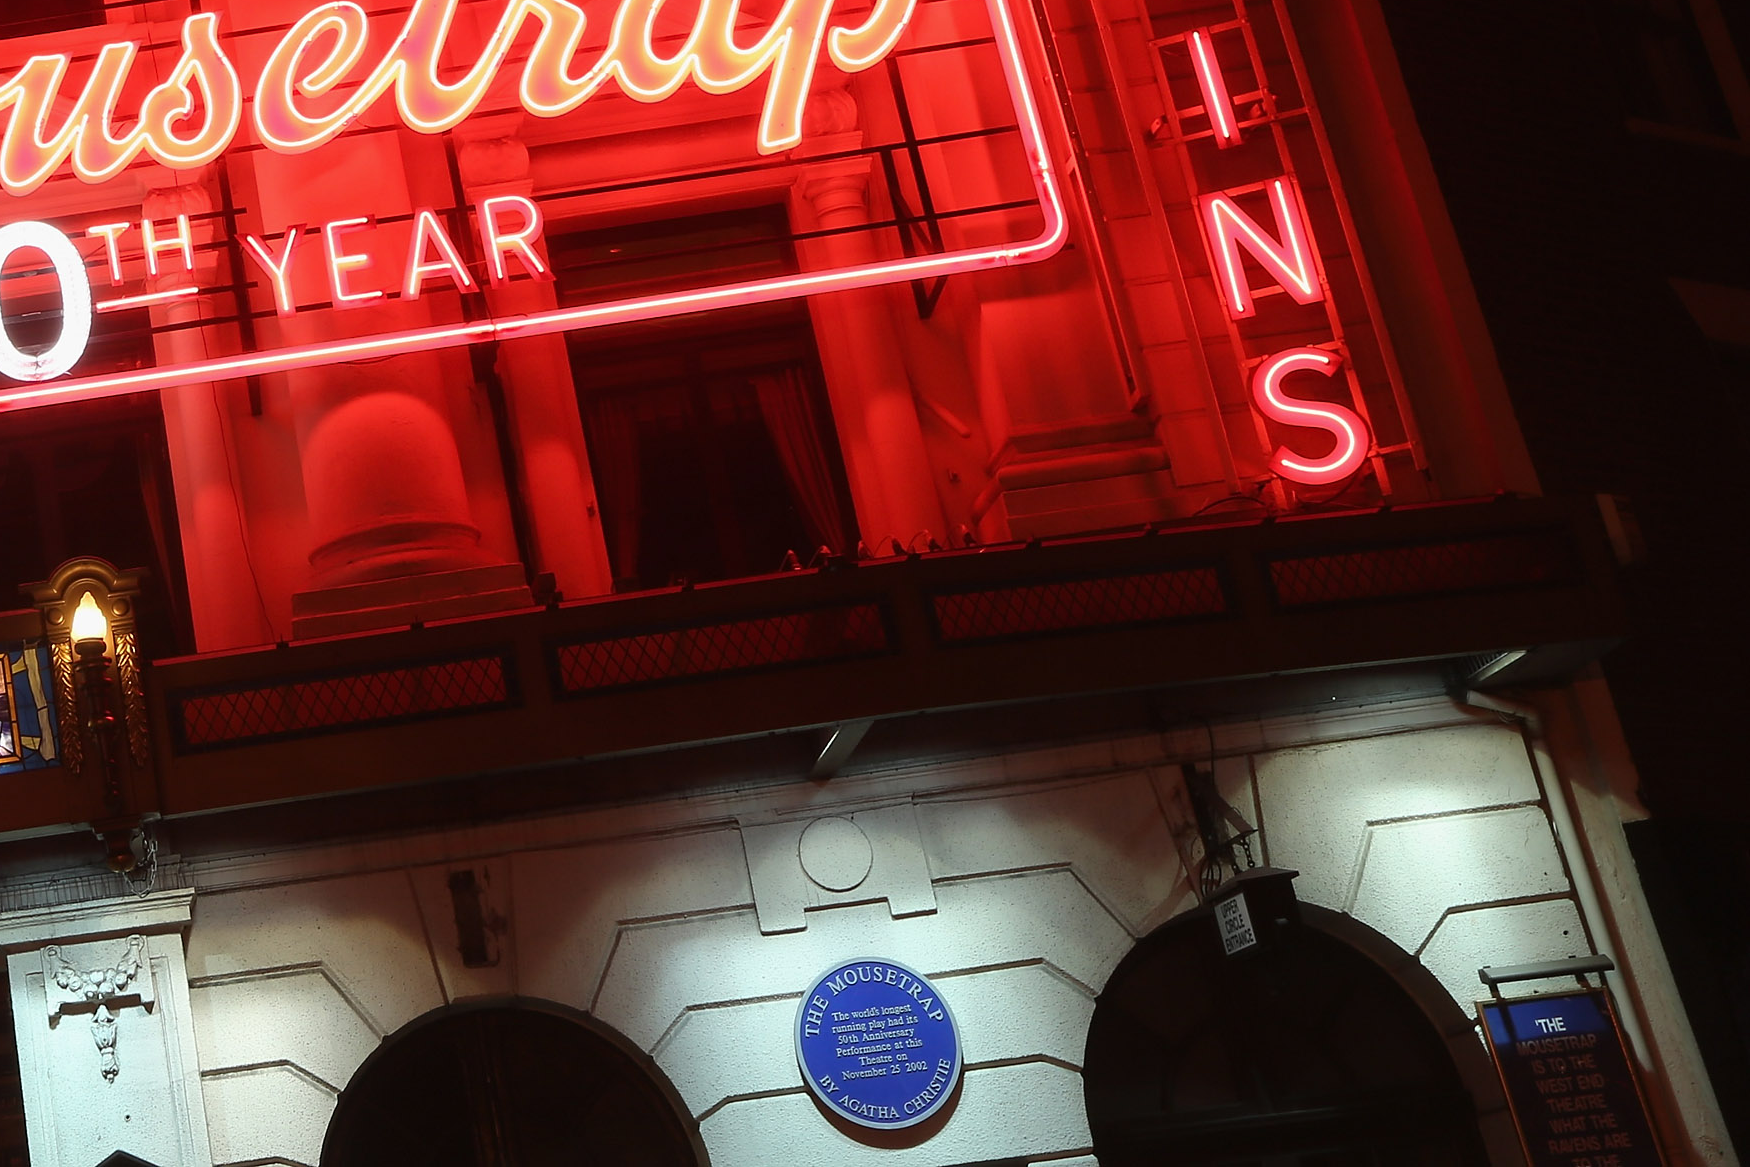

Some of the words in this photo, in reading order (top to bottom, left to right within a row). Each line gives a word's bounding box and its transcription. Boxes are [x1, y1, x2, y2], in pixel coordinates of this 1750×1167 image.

[237, 194, 557, 317] YEAR
[1220, 899, 1239, 919] UPPER
[1225, 914, 1245, 934] CIRCLE
[1225, 928, 1253, 952] ENTRANCE
[805, 994, 830, 1038] THE
[826, 966, 944, 1023] MOUSETRAP
[831, 1012, 850, 1021] The
[851, 1007, 880, 1018] world's
[881, 1004, 911, 1015] longest
[832, 1022, 866, 1033] running
[869, 1020, 885, 1031] play
[887, 1016, 904, 1026] had
[906, 1015, 919, 1024] its
[1535, 1016, 1567, 1034] 'THE
[838, 1034, 859, 1045] 50th
[862, 1028, 914, 1042] Anniversary
[1516, 1033, 1597, 1055] MOUSETRAP
[836, 1043, 892, 1057] Performance
[894, 1041, 903, 1049] at
[905, 1038, 923, 1048] this
[858, 1055, 893, 1066] Theatre
[896, 1053, 908, 1061] on
[1531, 1060, 1546, 1075] IS
[1549, 1057, 1568, 1073] TO
[1571, 1054, 1597, 1070] THE
[842, 1067, 887, 1080] November
[890, 1064, 901, 1074] 25
[905, 1061, 928, 1072] 2002
[819, 1075, 840, 1094] BY
[838, 1094, 900, 1119] AGATHA
[903, 1058, 951, 1114] CHRISTIE
[1535, 1076, 1574, 1095] WEST
[1577, 1073, 1605, 1089] END
[1546, 1094, 1608, 1114] THEATRE
[1548, 1115, 1587, 1134] WHAT
[1590, 1113, 1619, 1130] THE
[1548, 1135, 1601, 1154] RAVENS
[1605, 1132, 1633, 1149] ARE
